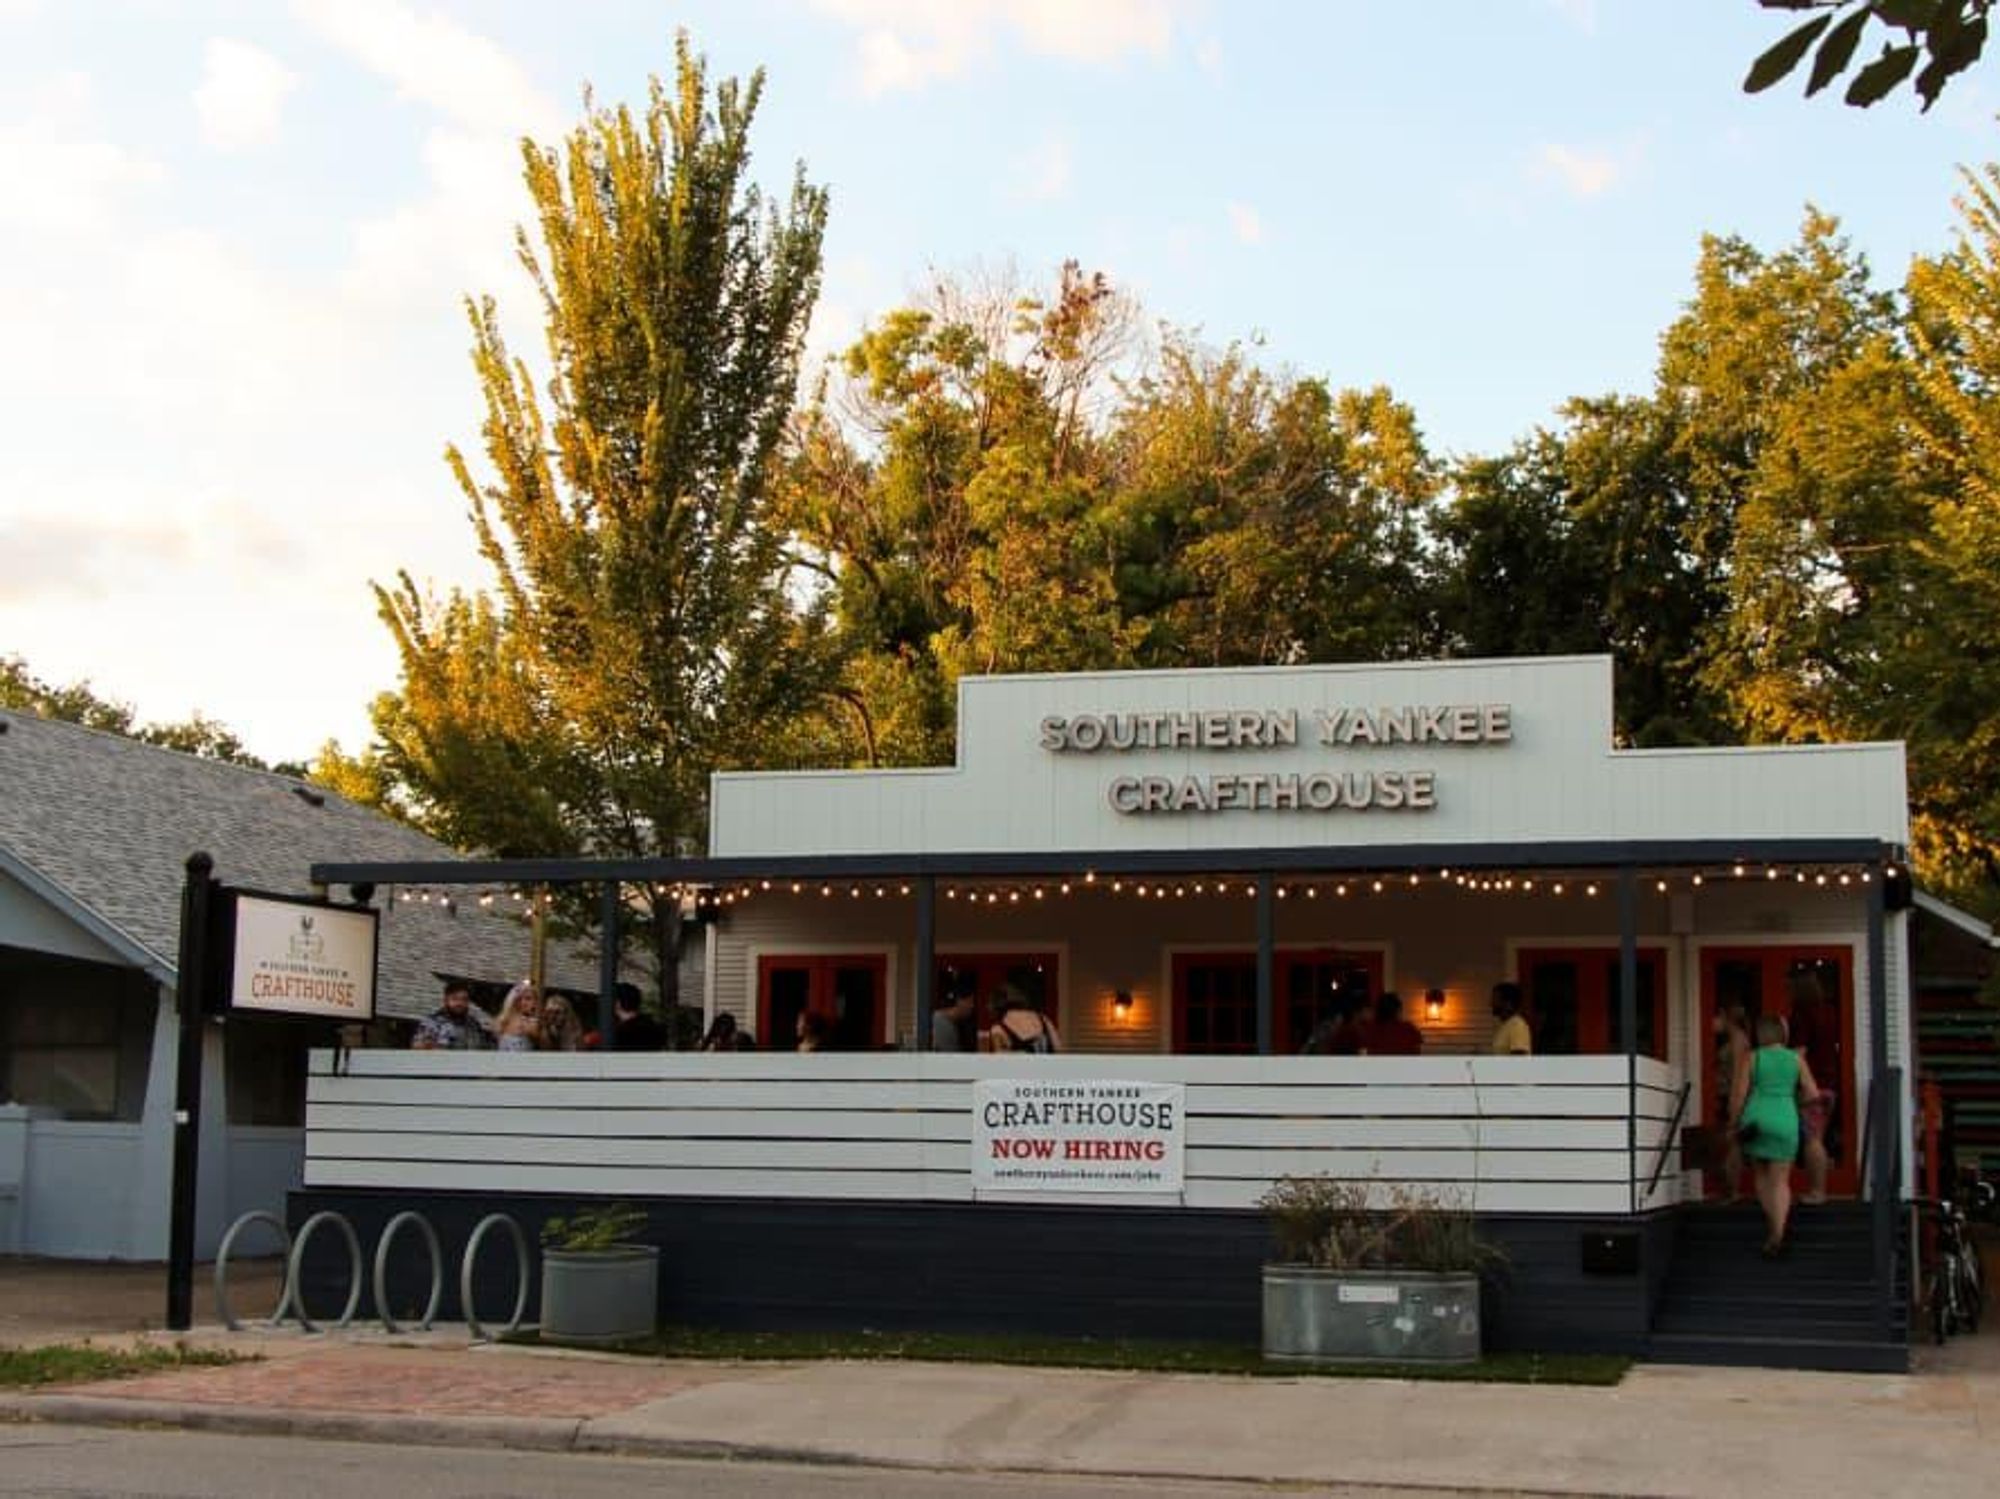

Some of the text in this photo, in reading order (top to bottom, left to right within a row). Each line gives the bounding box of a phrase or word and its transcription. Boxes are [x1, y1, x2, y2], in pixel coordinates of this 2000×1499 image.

[1039, 703, 1512, 753] SOUTHERN YANKEE
[1106, 769, 1438, 815] CRAFTHOUSE
[251, 972, 355, 1008] CRAFTHOUSE
[1014, 1086, 1085, 1098] SOUTHERN
[983, 1101, 1173, 1131] CRAFTHOUSE
[991, 1139, 1166, 1161] NOW HIRING
